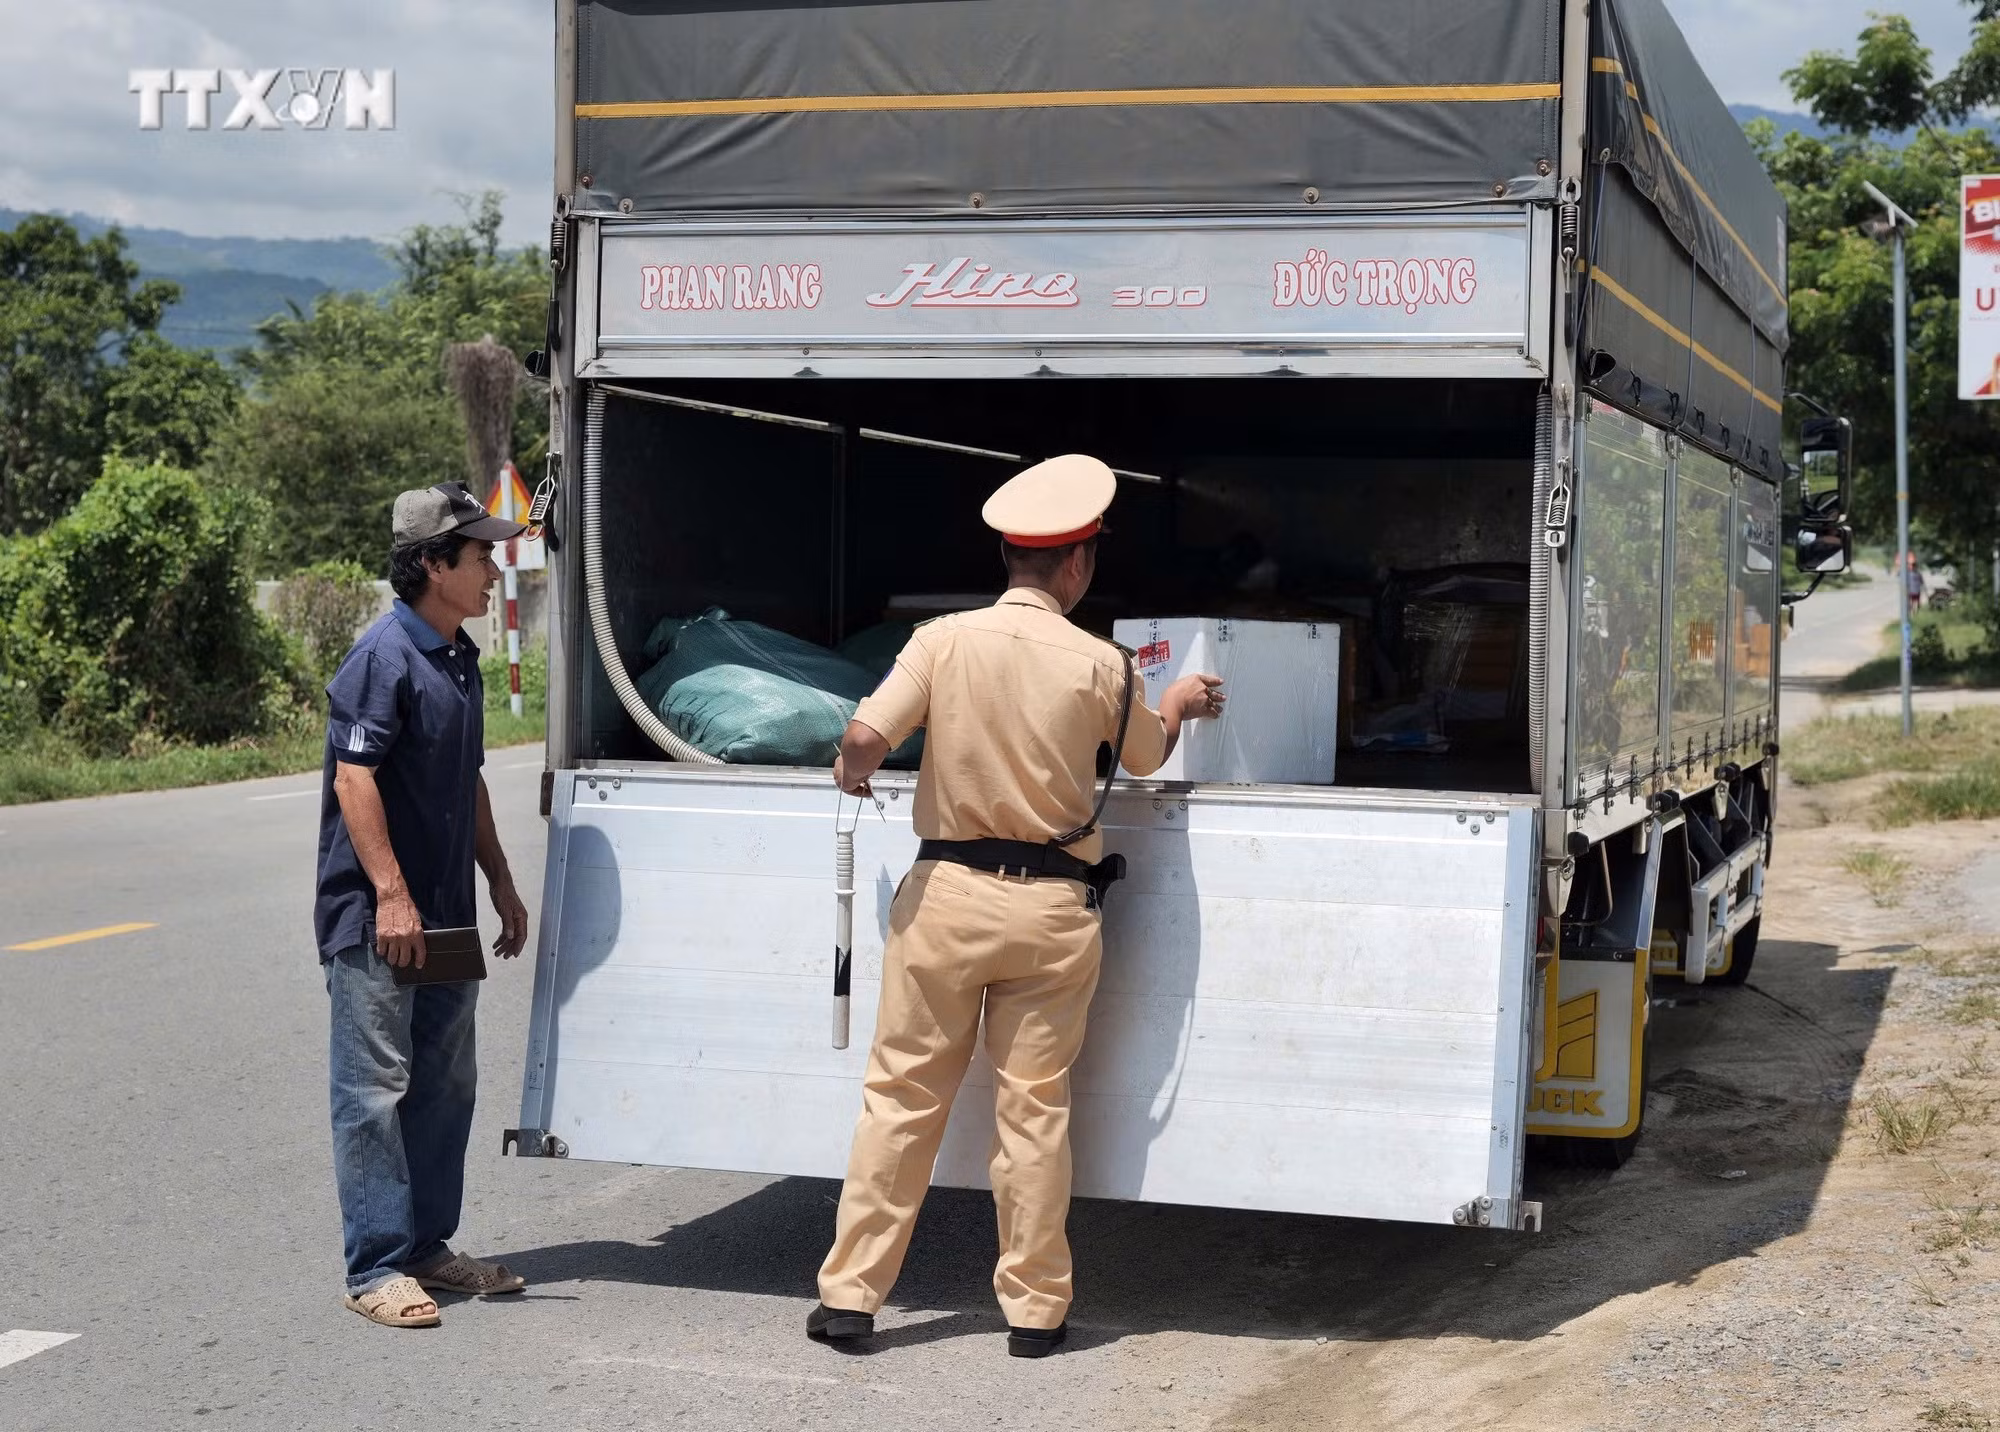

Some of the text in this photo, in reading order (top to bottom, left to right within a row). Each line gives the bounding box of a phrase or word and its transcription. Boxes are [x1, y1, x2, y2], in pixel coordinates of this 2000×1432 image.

[640, 263, 823, 311] PHAN RANG
[865, 257, 1208, 307] Hino 300
[1273, 248, 1477, 315] ĐỨC TRỌNG
